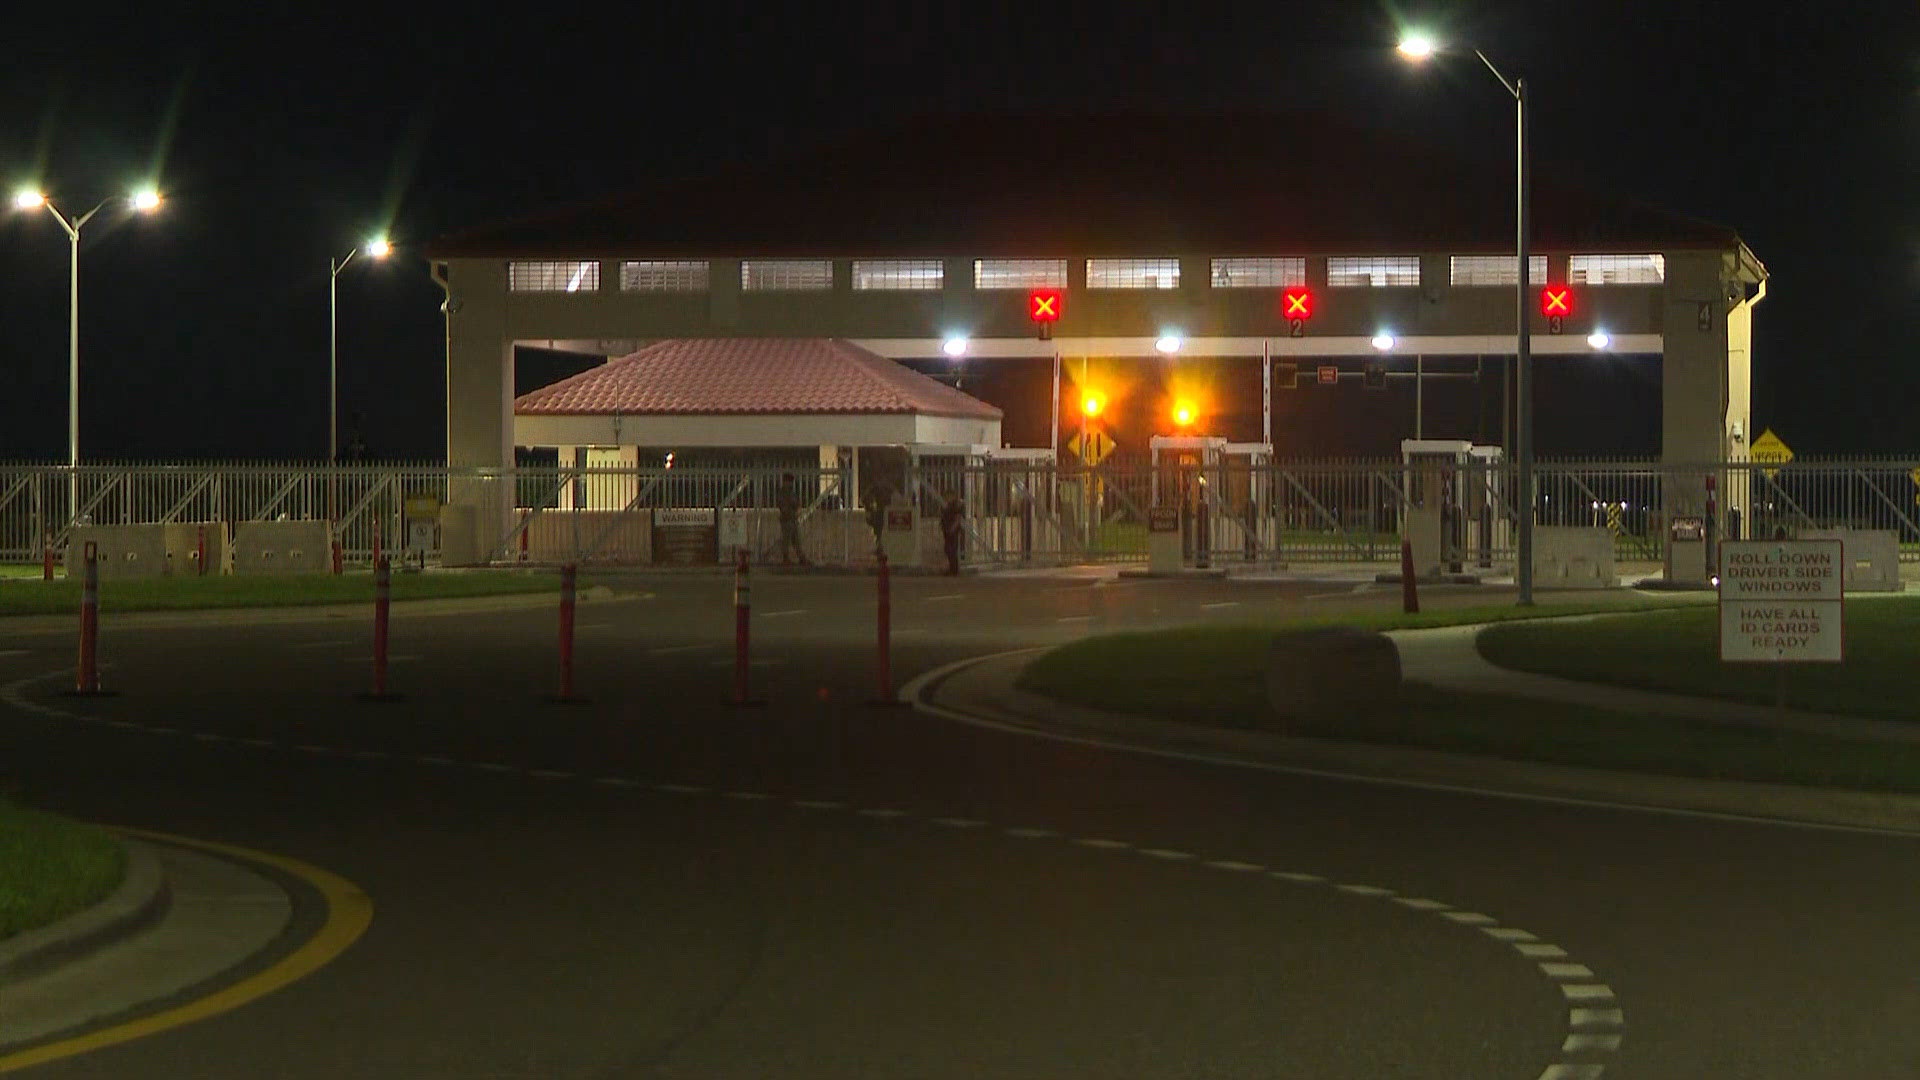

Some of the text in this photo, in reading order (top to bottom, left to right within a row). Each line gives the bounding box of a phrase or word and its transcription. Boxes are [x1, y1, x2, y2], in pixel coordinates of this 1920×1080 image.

[1699, 304, 1710, 328] 4
[1292, 318, 1303, 337] 2
[1551, 315, 1561, 333] 3
[661, 513, 708, 523] WARNING
[1730, 553, 1831, 564] ROLL DOWN
[1728, 566, 1833, 578] DRIVER SIDE
[1739, 580, 1822, 592] WINDOWS
[1741, 608, 1820, 620] HAVE ALL
[1741, 622, 1820, 634] ID CARDS
[1752, 636, 1809, 647] READY
